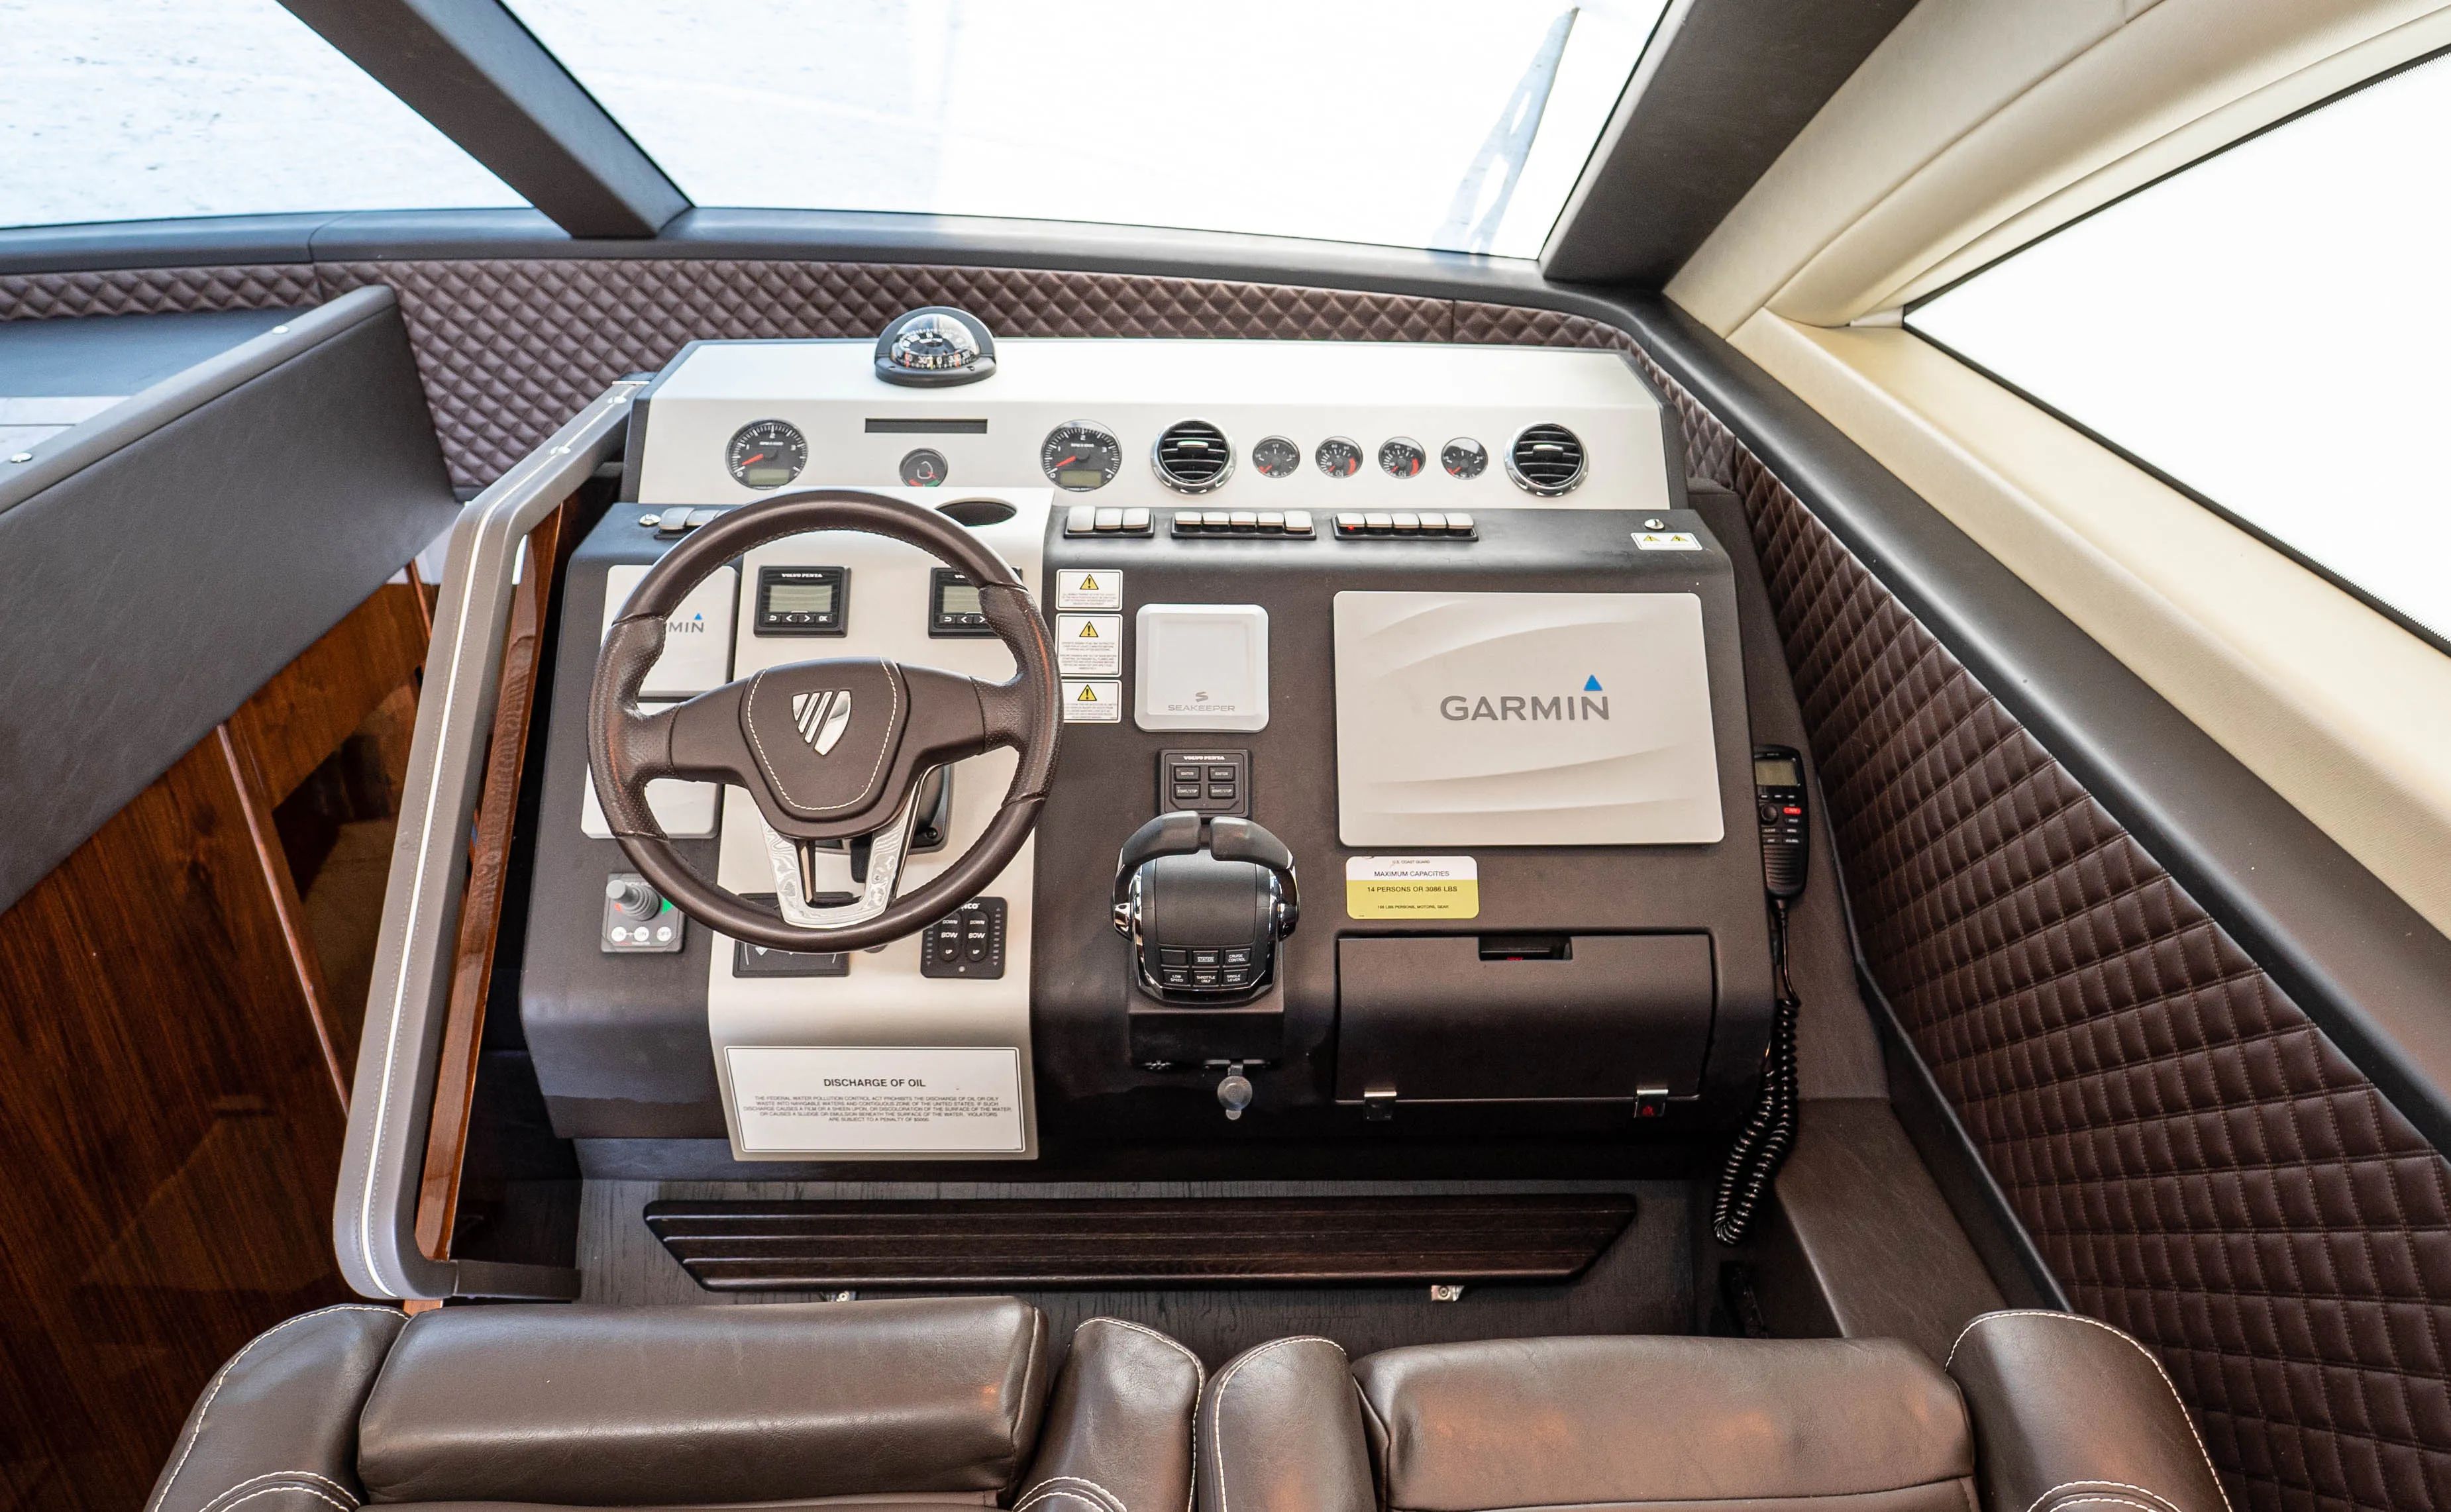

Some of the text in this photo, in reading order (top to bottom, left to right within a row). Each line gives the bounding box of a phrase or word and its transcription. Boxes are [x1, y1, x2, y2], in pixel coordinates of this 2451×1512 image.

[668, 622, 704, 632] MIN
[1440, 695, 1610, 721] GARMIN
[823, 1078, 888, 1087] DISCHARGE
[890, 1078, 905, 1087] OF
